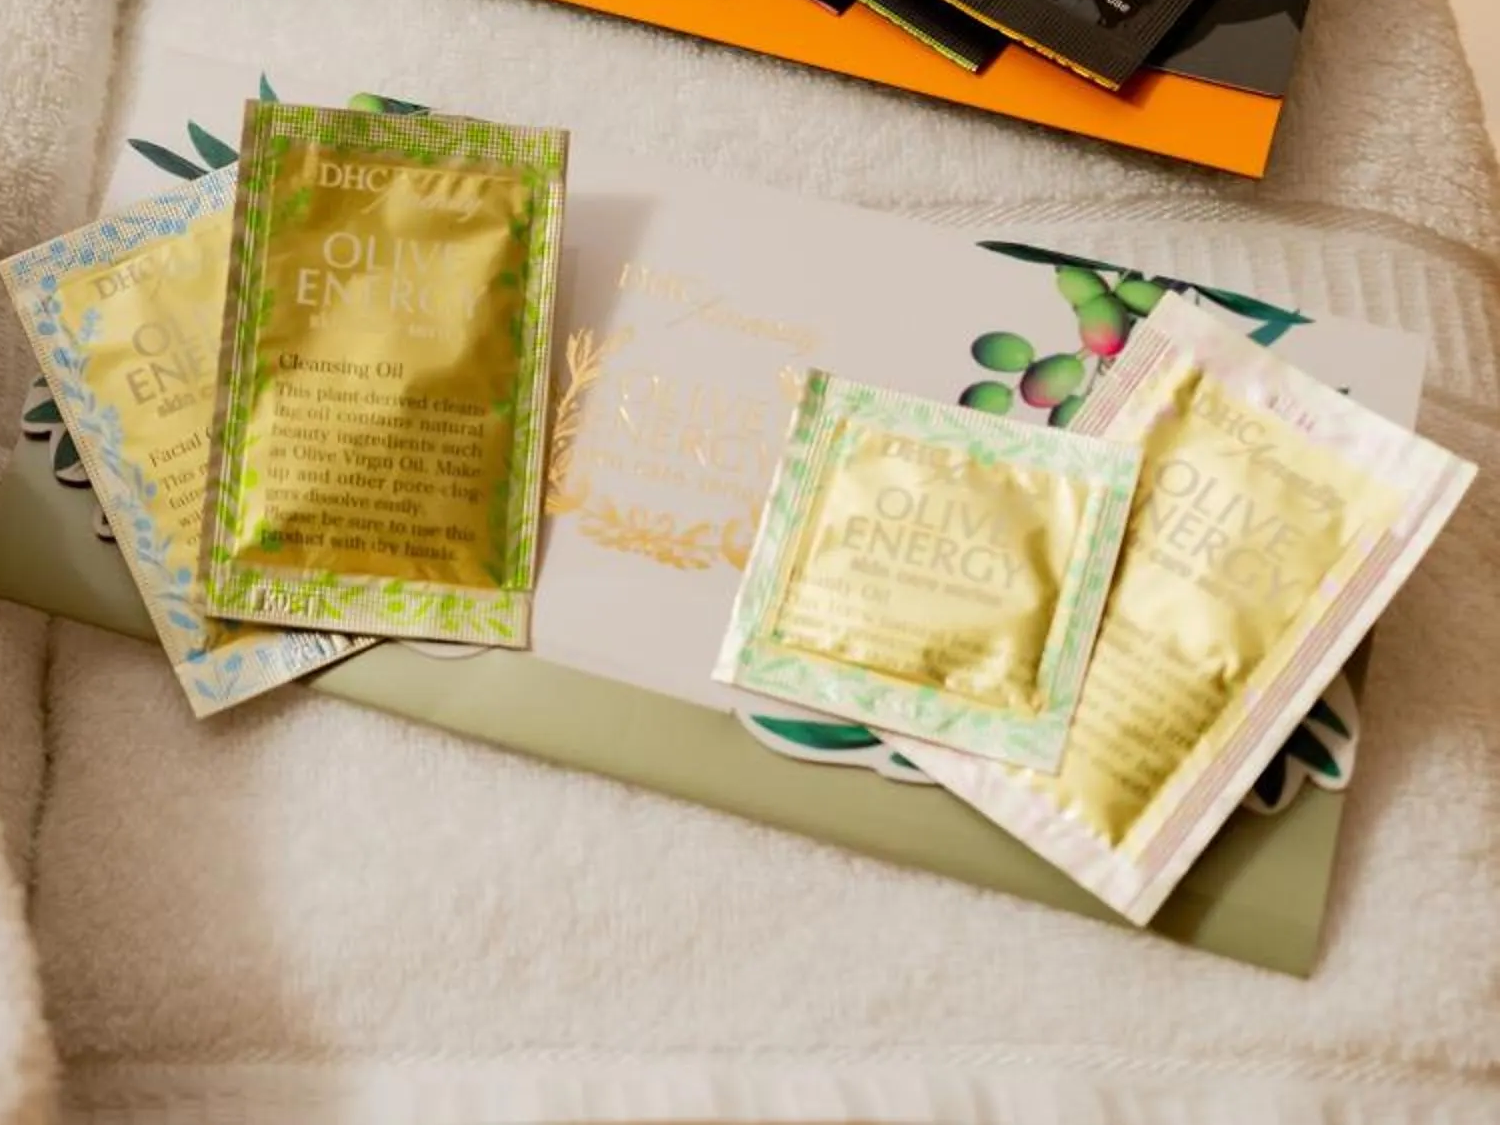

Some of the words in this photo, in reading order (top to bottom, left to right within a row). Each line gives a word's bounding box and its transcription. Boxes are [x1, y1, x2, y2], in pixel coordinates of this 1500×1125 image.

[320, 163, 387, 192] DHC
[278, 351, 370, 378] Cleansing
[375, 360, 404, 379] Oil
[273, 381, 310, 400] This
[307, 406, 330, 421] oil
[336, 411, 413, 429] contains
[419, 417, 484, 437] natural
[1194, 392, 1265, 446] DHC
[148, 432, 202, 469] Facial
[271, 424, 329, 444] beauty
[336, 430, 435, 453] ingredients
[441, 440, 483, 458] such
[269, 446, 286, 459] as
[292, 445, 337, 463] Olive
[342, 449, 393, 471] Virgin
[267, 467, 289, 483] up
[296, 467, 330, 484] and
[337, 471, 386, 490] other
[303, 488, 370, 509] dissolve
[1156, 459, 1291, 561] OLIVE
[261, 527, 324, 548] product
[264, 505, 316, 525] Please
[321, 512, 345, 527] be
[348, 516, 385, 532] sure
[389, 520, 408, 534] to
[445, 523, 475, 542] this
[843, 515, 1025, 589] ENERGY
[1142, 494, 1299, 599] NERGY
